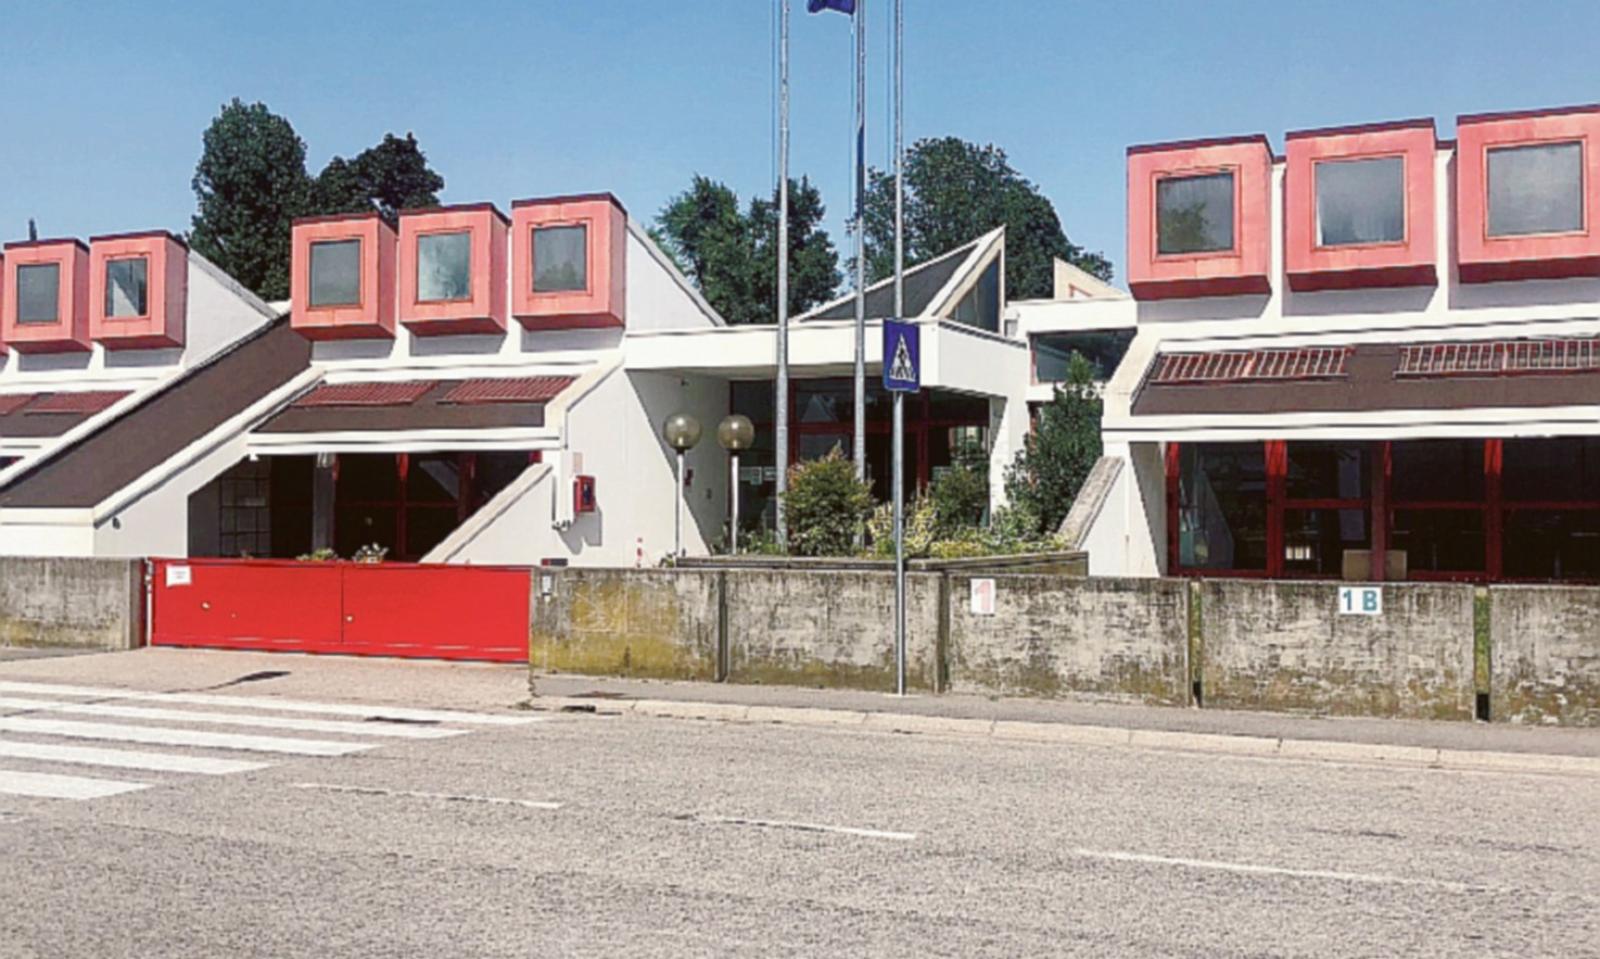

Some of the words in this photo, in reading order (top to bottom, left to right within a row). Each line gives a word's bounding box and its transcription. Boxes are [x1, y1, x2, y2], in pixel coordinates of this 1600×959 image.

[975, 581, 991, 611] 1
[1343, 590, 1352, 610] 1
[1362, 590, 1377, 611] B
